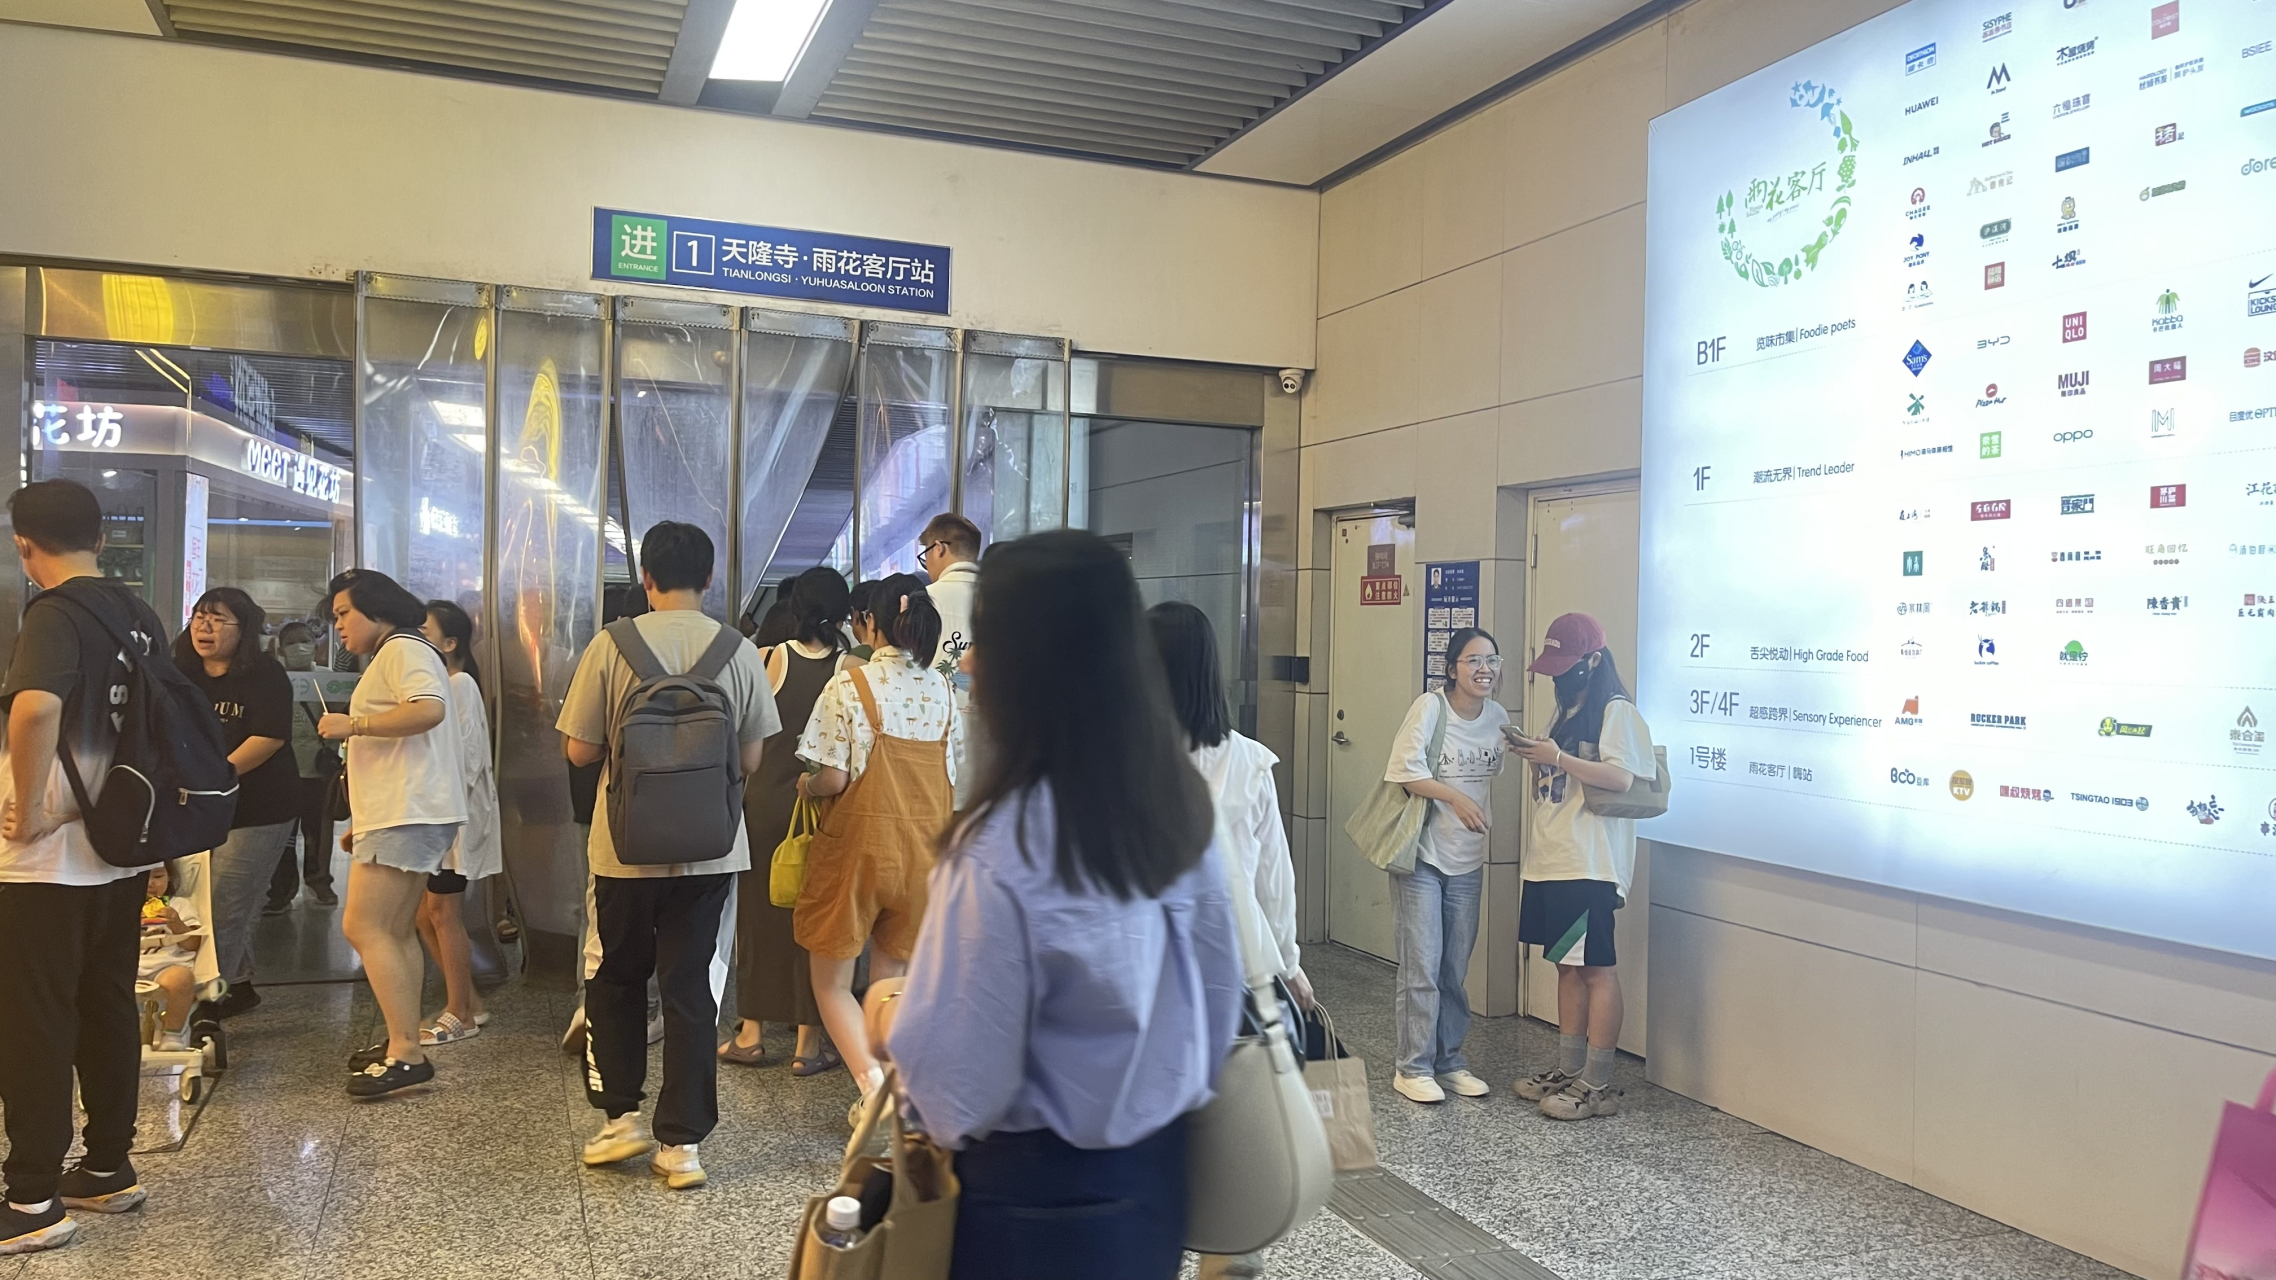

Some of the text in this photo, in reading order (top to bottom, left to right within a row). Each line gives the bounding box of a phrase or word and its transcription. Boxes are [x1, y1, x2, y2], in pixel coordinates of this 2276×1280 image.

[1904, 96, 1939, 116] HUAWEI
[620, 224, 658, 261] 进
[686, 239, 699, 267] 1
[721, 236, 935, 285] 天隆寺·雨花客厅站
[618, 262, 659, 273] ENTRANCE
[722, 267, 935, 299] TIANLONGSI YUHUASALOON STATION
[1799, 318, 1856, 340] Foodie poets
[2065, 315, 2084, 328] UNI
[2065, 327, 2085, 340] QLO
[1696, 336, 1727, 366] B1F
[2057, 370, 2090, 390] MUJI
[247, 441, 290, 484] MEET
[1797, 461, 1855, 478] Trend Leader
[1693, 466, 1711, 491] 1F
[1753, 466, 1793, 484] 潮流无界
[1690, 633, 1711, 658] 2F
[1750, 646, 1789, 661] 舌尖悦动
[1793, 649, 1869, 663] High Grade Food
[1690, 689, 1740, 717] 3F/4F
[1749, 706, 1788, 721] 超感跨界
[1792, 709, 1882, 728] Sensory Experiencer
[1971, 713, 2027, 726] RUCKER PARK
[1690, 746, 1727, 771] 1号楼
[1749, 761, 1786, 778] 雨花客厅
[1953, 787, 1970, 796] KTV
[2070, 792, 2110, 805] TSINGTAO
